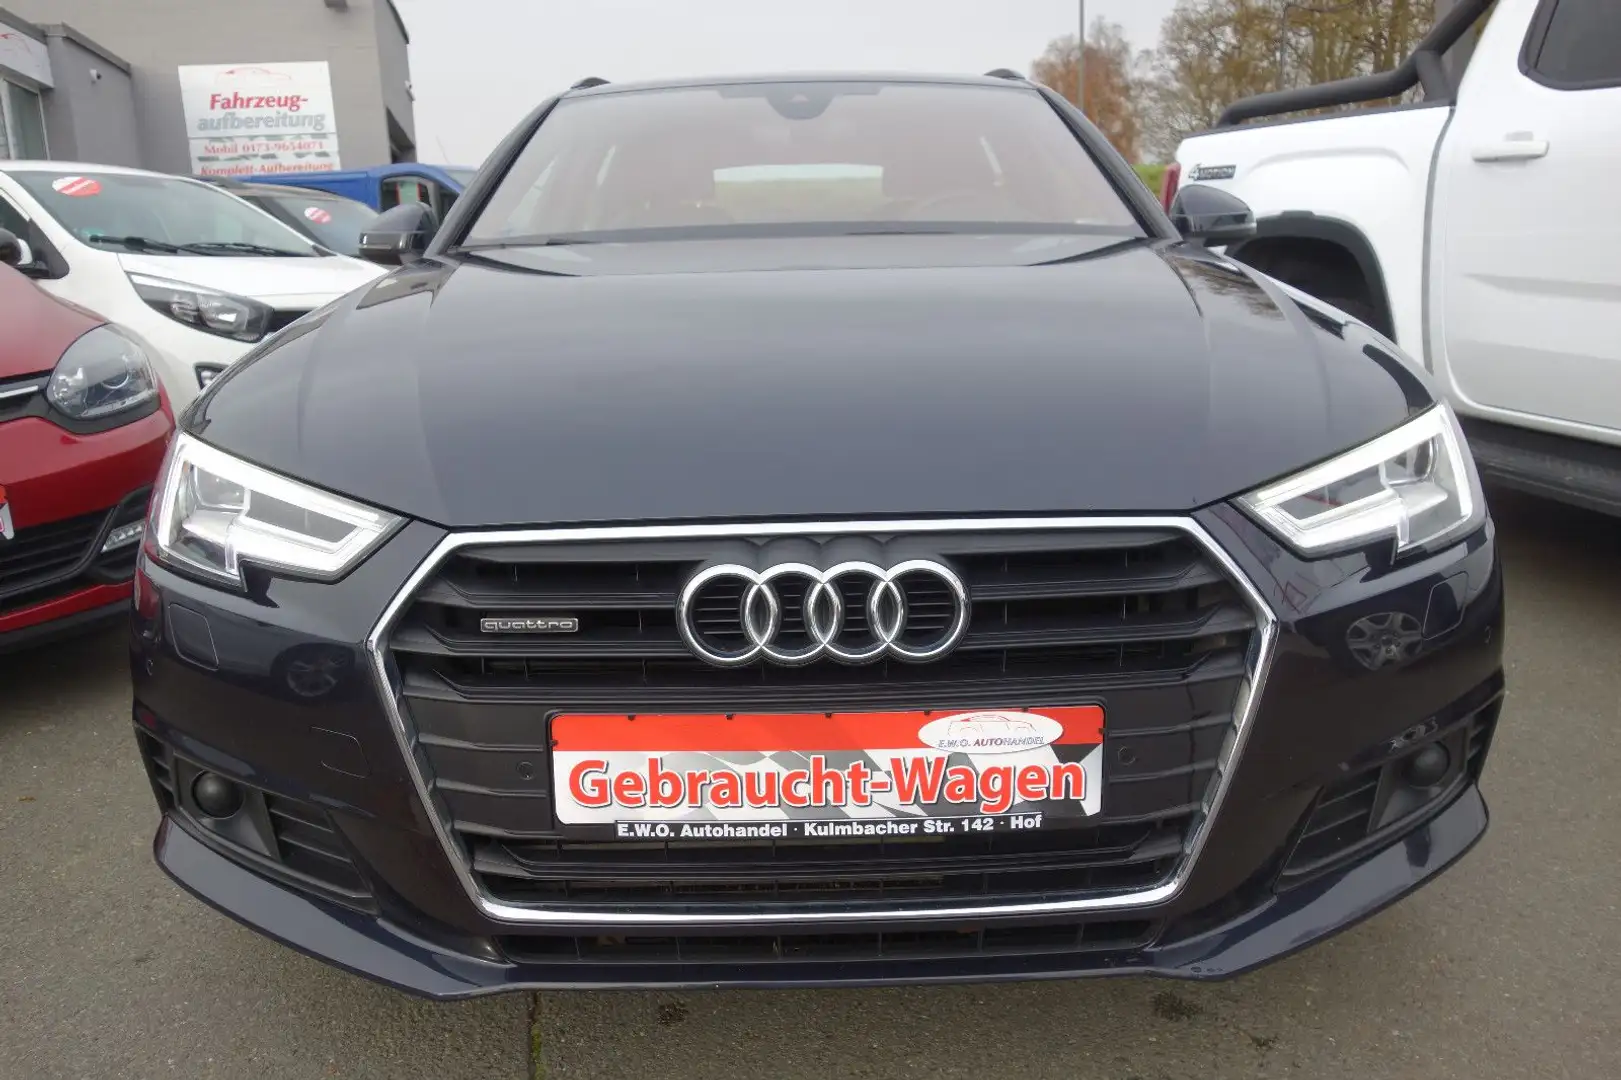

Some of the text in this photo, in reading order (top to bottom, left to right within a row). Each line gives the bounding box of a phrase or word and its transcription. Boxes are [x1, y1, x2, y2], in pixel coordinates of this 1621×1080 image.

[210, 92, 308, 112] Fahrzeug-
[197, 111, 325, 131] aufbereitung
[204, 143, 238, 154] Mobil
[484, 620, 573, 630] quattro
[938, 736, 1045, 748] E.W.O. AUTOHANDEL
[567, 755, 1088, 815] Gebraucht-Wagen
[616, 814, 1042, 838] E.W.O. Autohandel Kulmbacher Str. 142 Hof
